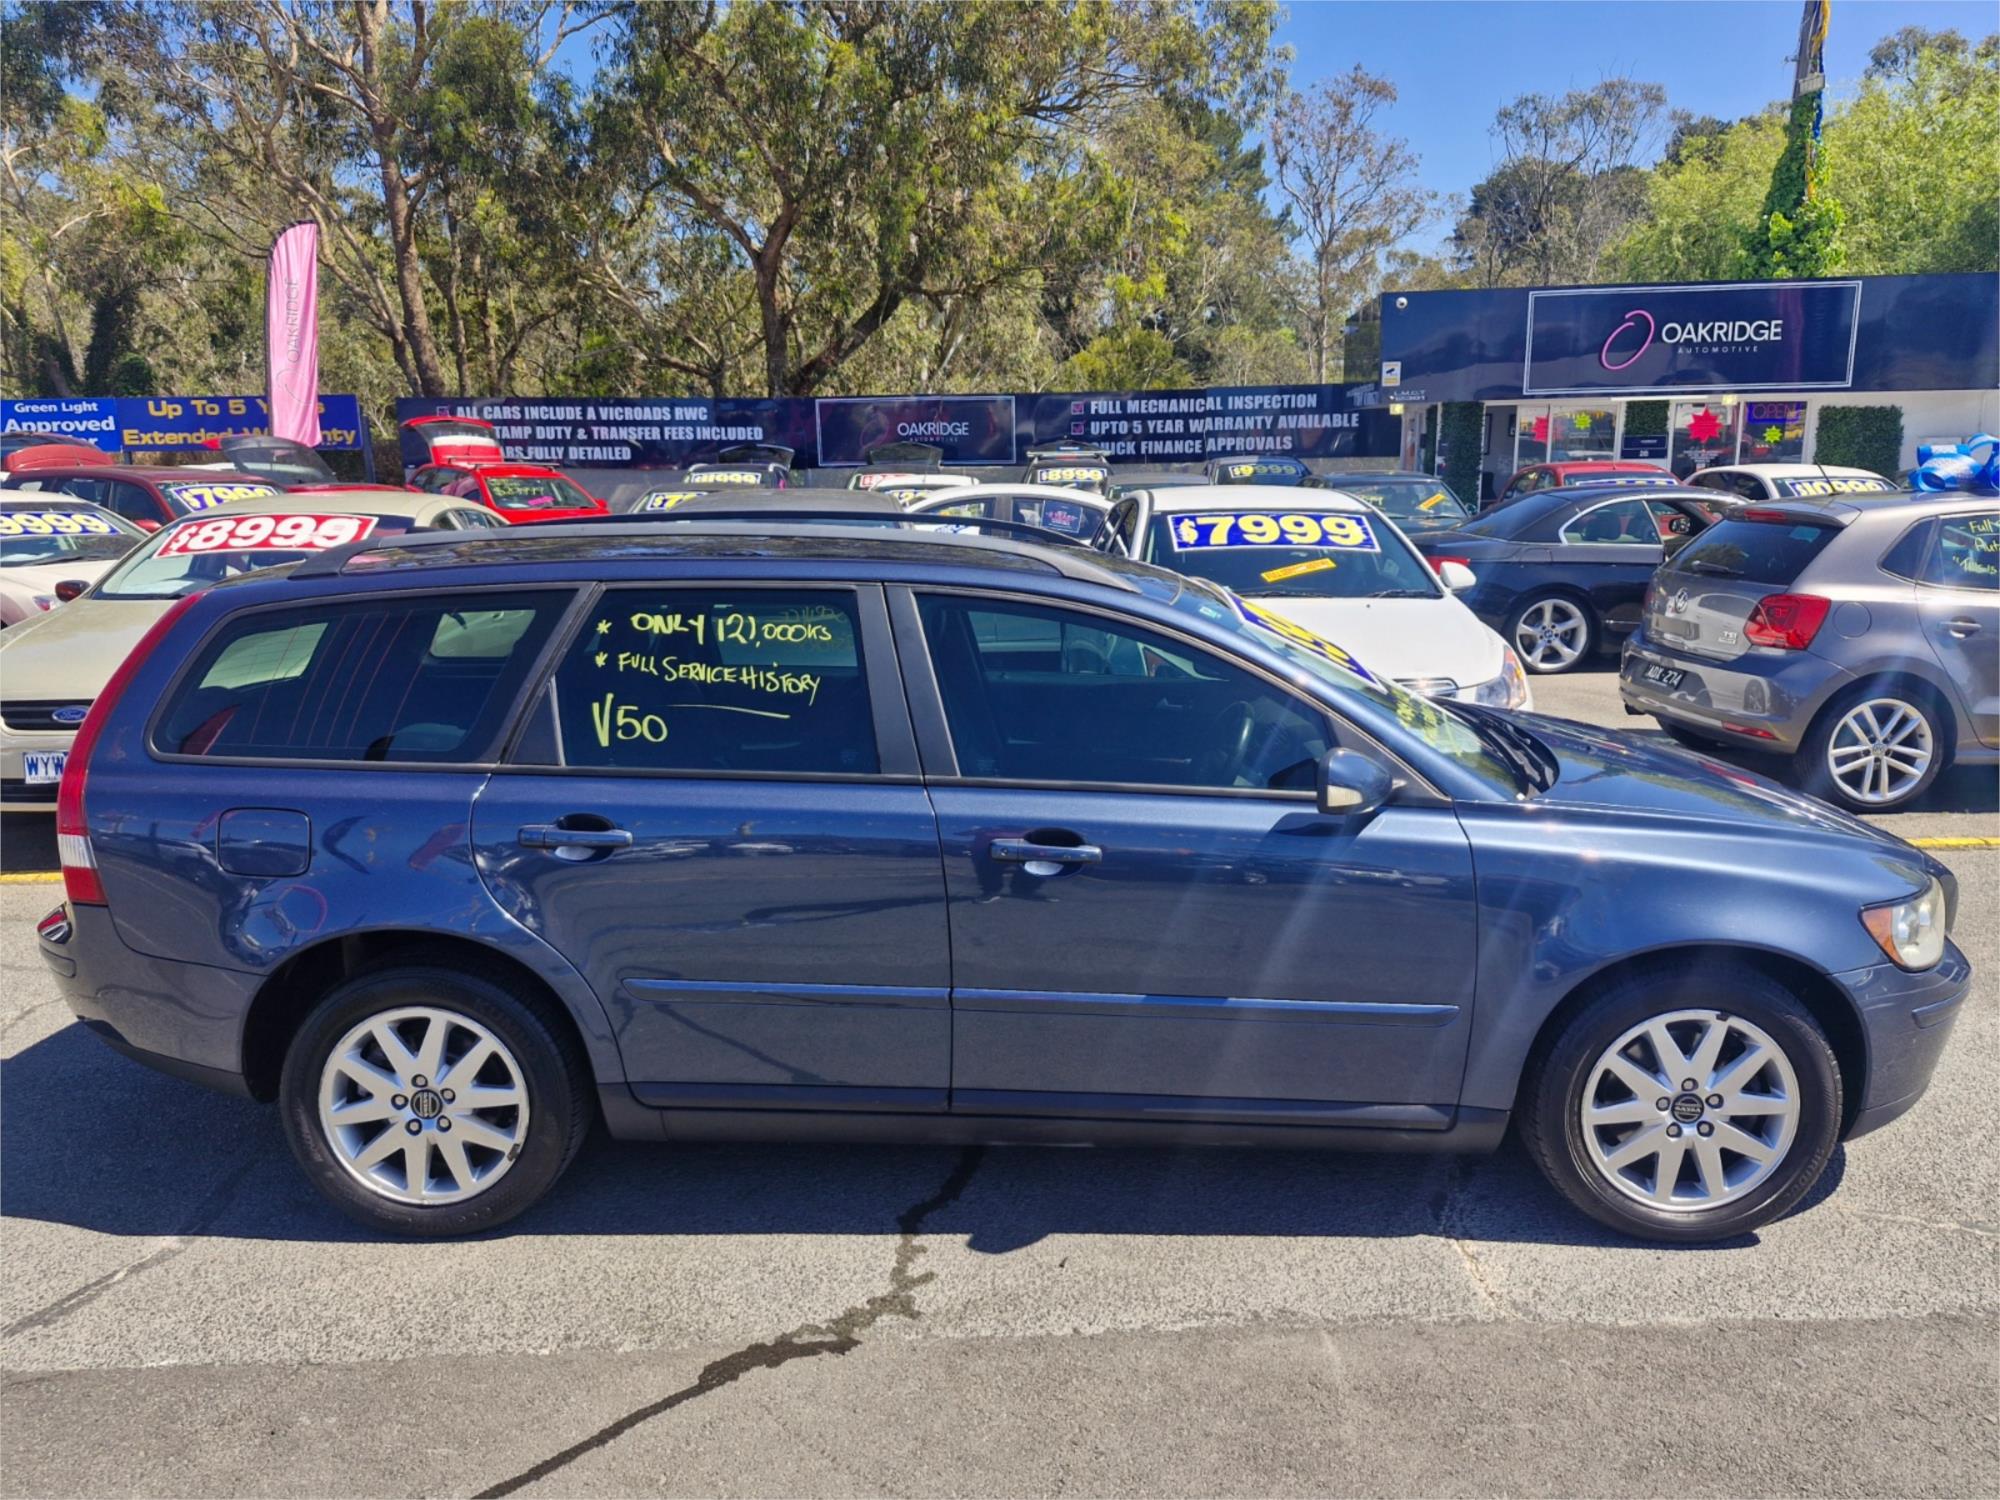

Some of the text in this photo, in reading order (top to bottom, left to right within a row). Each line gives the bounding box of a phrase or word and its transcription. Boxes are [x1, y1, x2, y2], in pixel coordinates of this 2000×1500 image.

[1661, 320, 1783, 343] OAKRIDGE
[1678, 345, 1758, 354] AUTOMOTIVE
[14, 401, 99, 414] Green Light
[148, 401, 183, 419] Up
[191, 400, 220, 416] To
[229, 400, 247, 415] 5
[1090, 393, 1317, 414] FULL MECHANICAL INSPECTION
[456, 406, 708, 421] ALL CARS INCLUDE A VICROADS RWC
[4, 416, 116, 432] Approved
[489, 425, 533, 440] TAMP
[536, 426, 572, 440] DUTY
[577, 427, 588, 440] &
[591, 426, 661, 441] TRANSFER
[664, 427, 694, 441] FEES
[697, 427, 763, 441] INCLUDED
[897, 422, 970, 436] OAKRIDGE
[1132, 420, 1143, 434] 5
[1147, 419, 1184, 433] YEAR
[1189, 415, 1274, 433] WARRANTY
[1277, 413, 1360, 429] AVAILABLE
[502, 446, 632, 461] ARS FULLY DETAILED
[1140, 439, 1203, 454] FINANCE
[1206, 436, 1293, 452] APPROVALS
[166, 516, 361, 552] $8999
[1178, 514, 1367, 546] $7999
[630, 613, 705, 645] ONLY
[618, 652, 821, 706] FULL SERVICE HISTORY
[592, 693, 668, 747] V50
